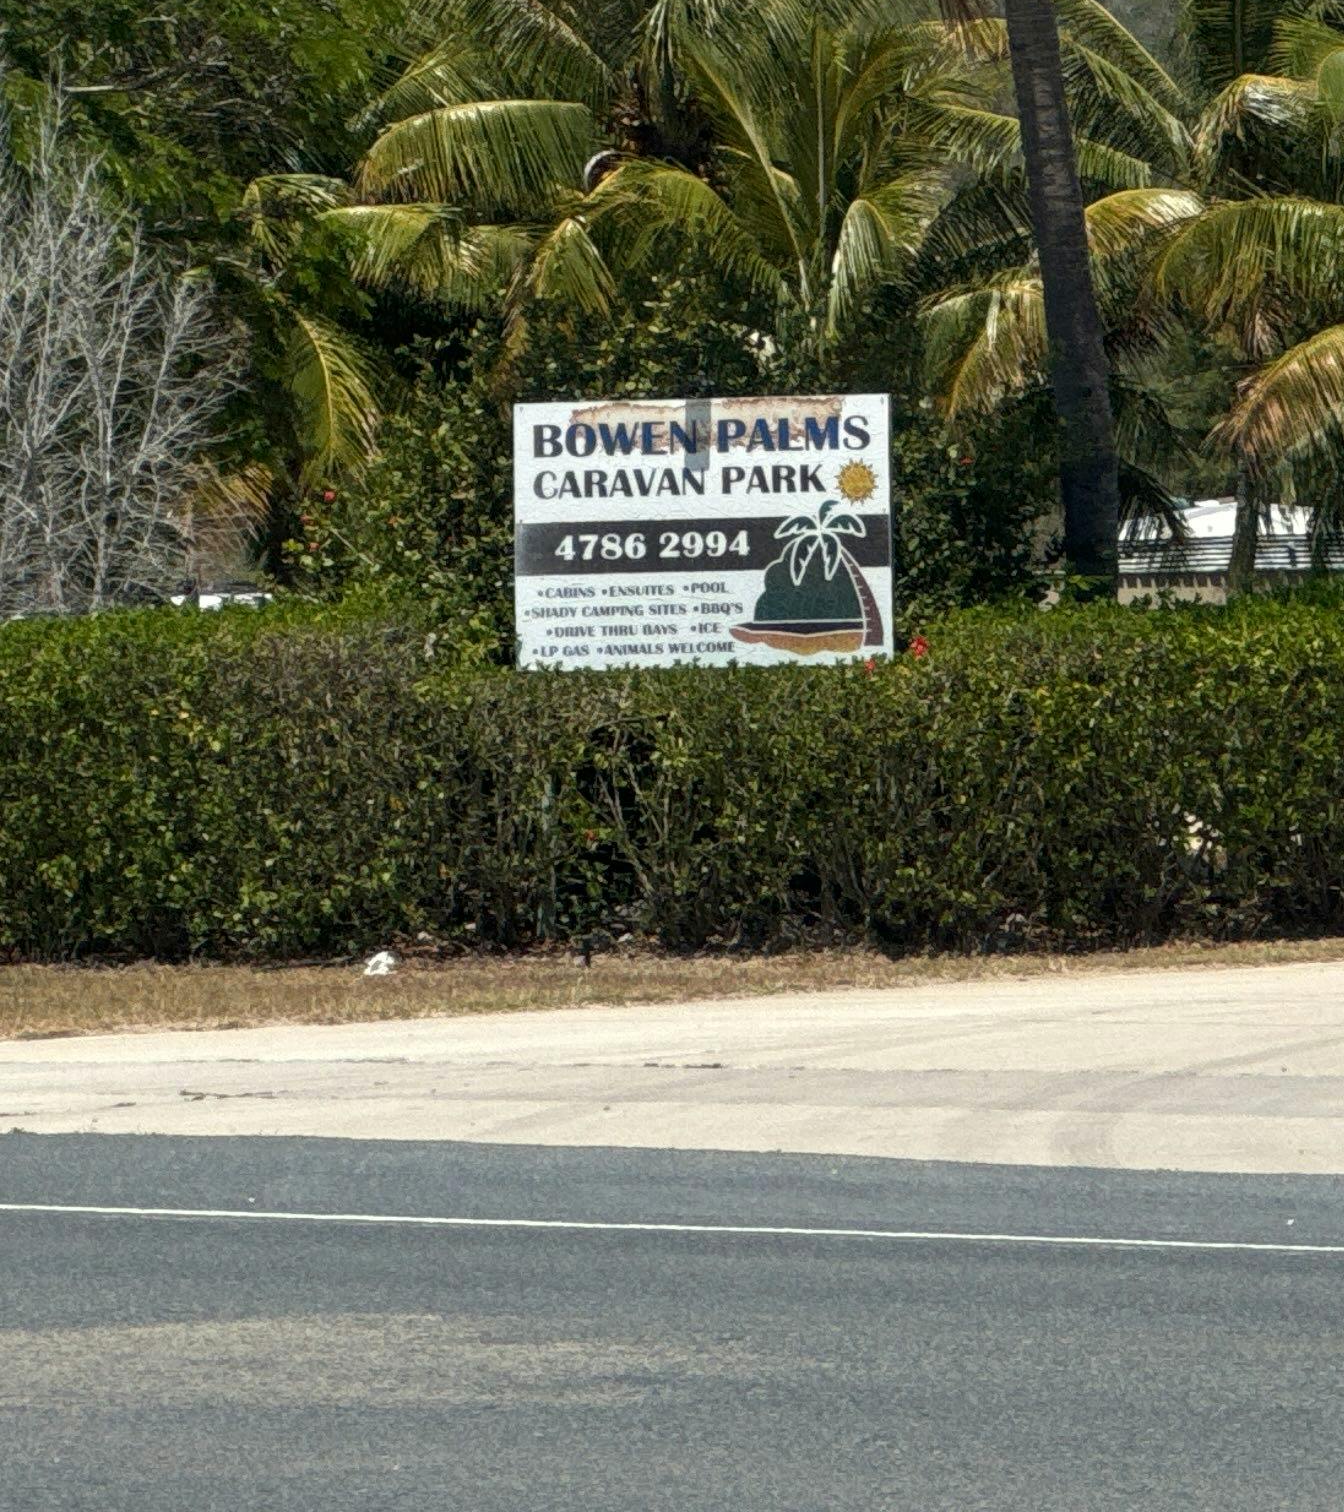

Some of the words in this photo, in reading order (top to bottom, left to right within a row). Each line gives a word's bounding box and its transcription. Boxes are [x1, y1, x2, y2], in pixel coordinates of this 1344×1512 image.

[533, 421, 697, 458] BOWEN
[717, 416, 870, 453] PALMS
[533, 468, 704, 500] CARAVAN
[722, 465, 826, 494] PARK
[554, 534, 645, 560] 4786
[659, 530, 749, 558] 2994
